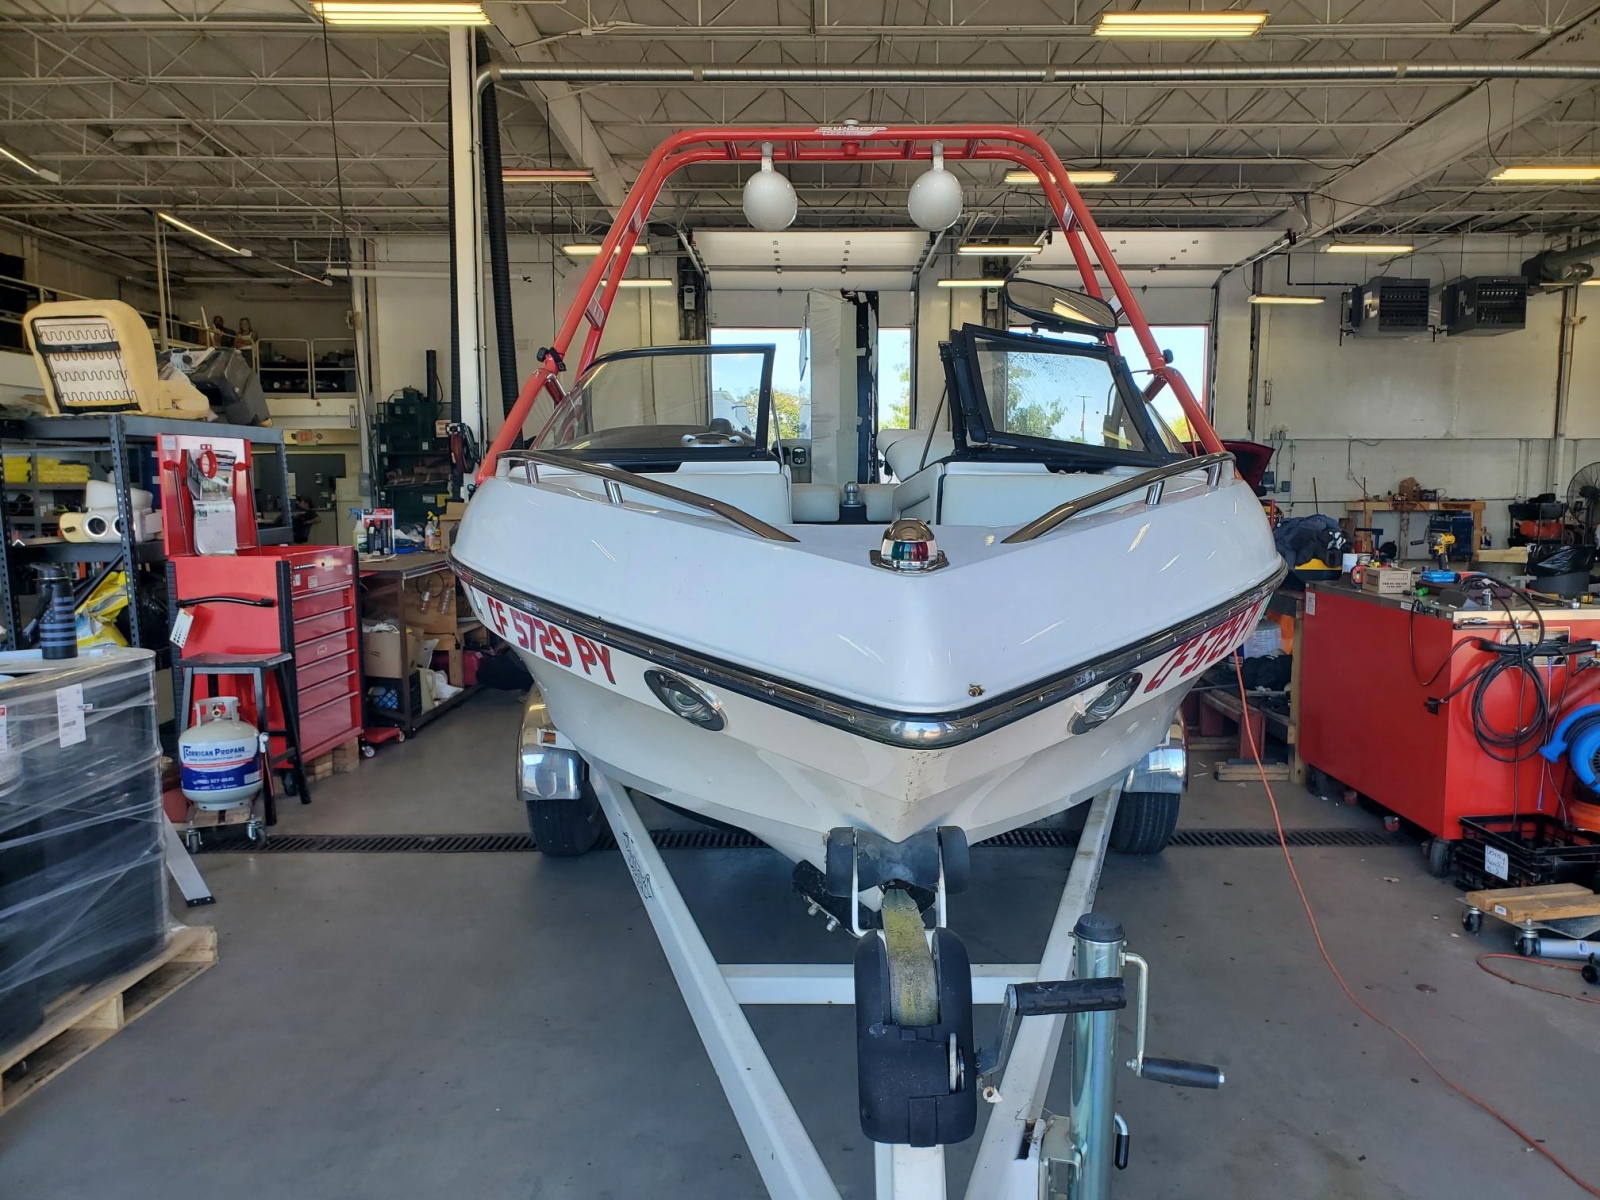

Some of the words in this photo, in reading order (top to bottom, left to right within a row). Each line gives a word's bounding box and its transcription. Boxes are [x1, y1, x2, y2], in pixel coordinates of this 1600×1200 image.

[487, 597, 509, 638] CF
[509, 607, 573, 668] 5729
[572, 633, 616, 685] PY
[1144, 635, 1203, 694] CF
[1179, 611, 1247, 678] 5729
